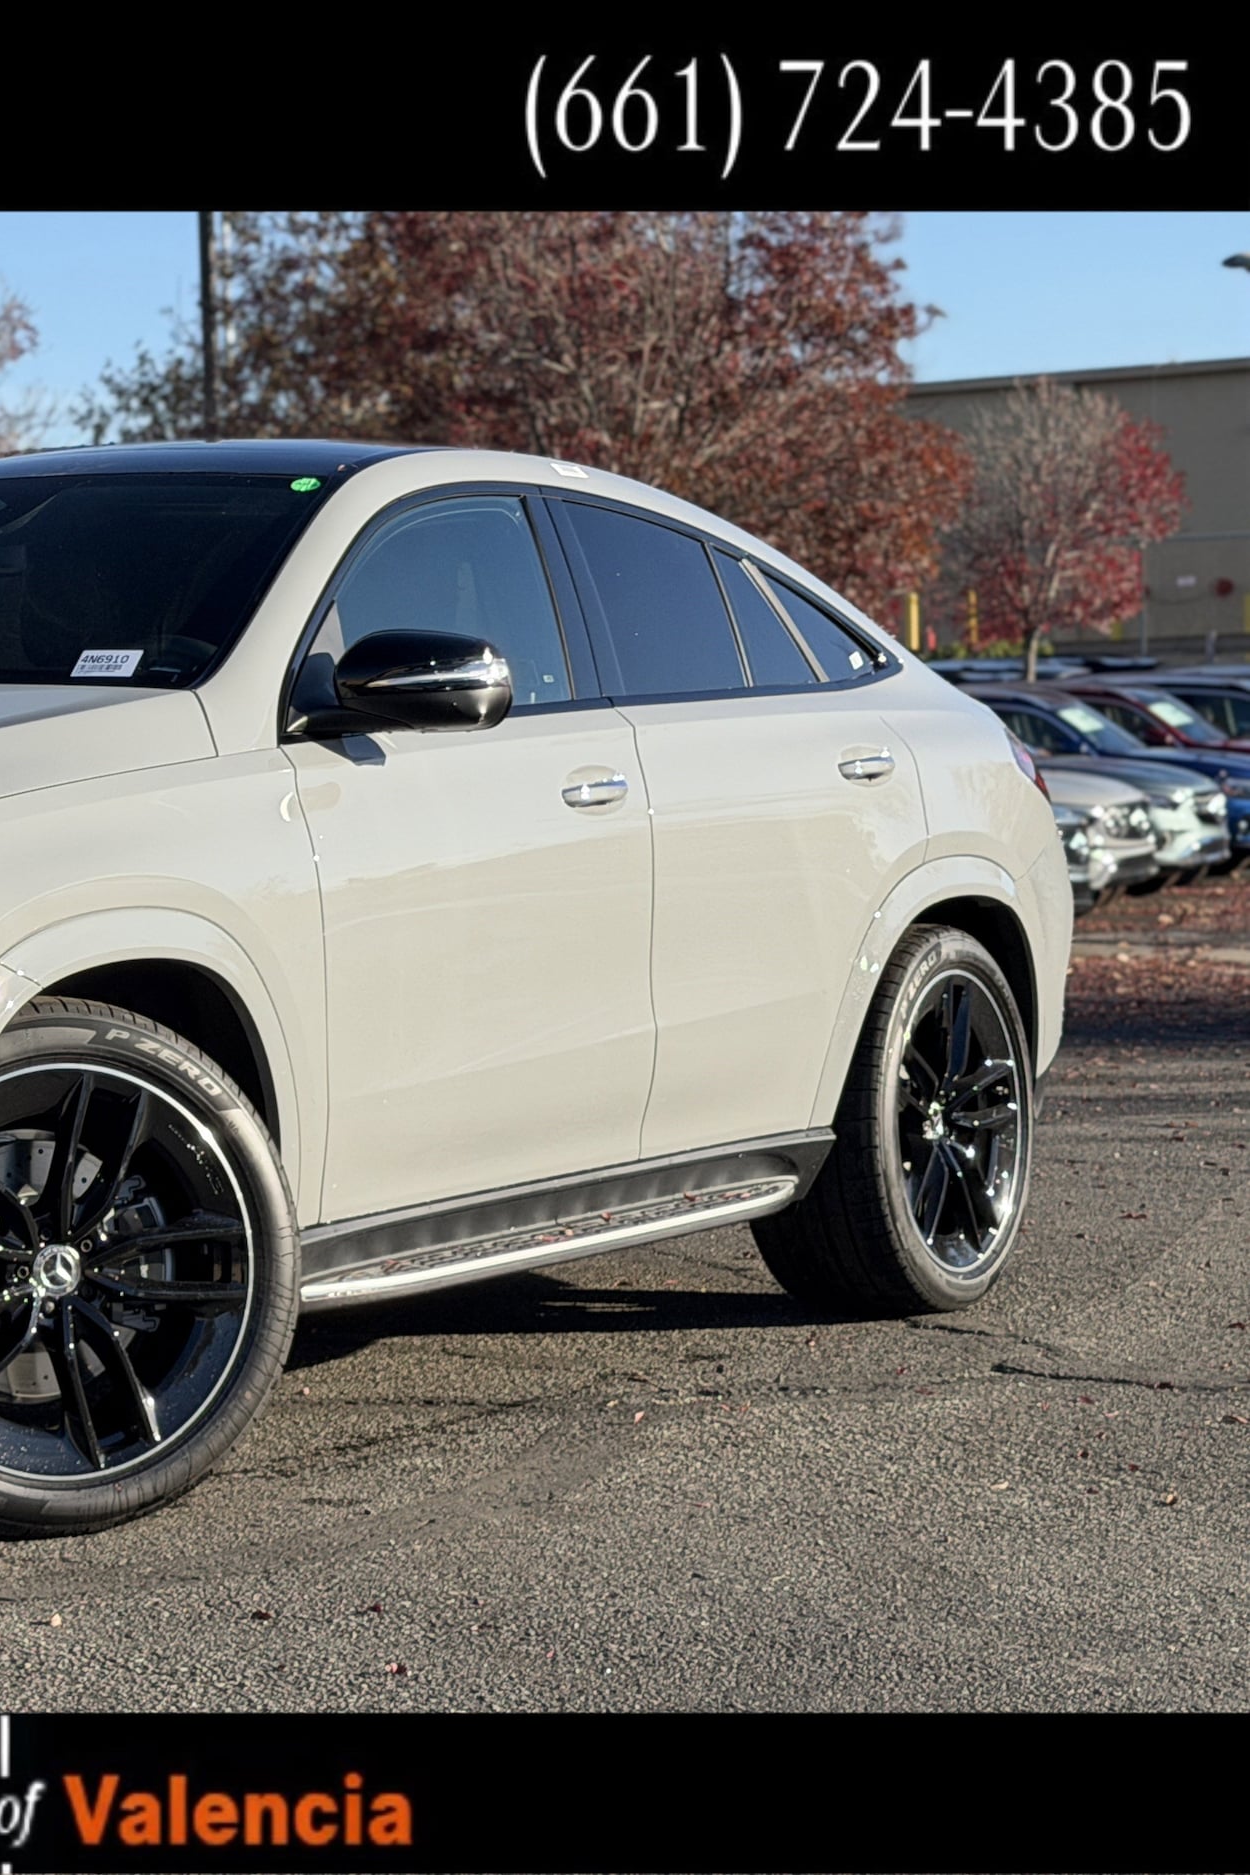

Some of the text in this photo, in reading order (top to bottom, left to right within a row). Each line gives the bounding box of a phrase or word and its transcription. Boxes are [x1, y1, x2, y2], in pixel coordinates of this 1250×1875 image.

[80, 654, 130, 663] 4N6910
[105, 1028, 222, 1096] P ZERO
